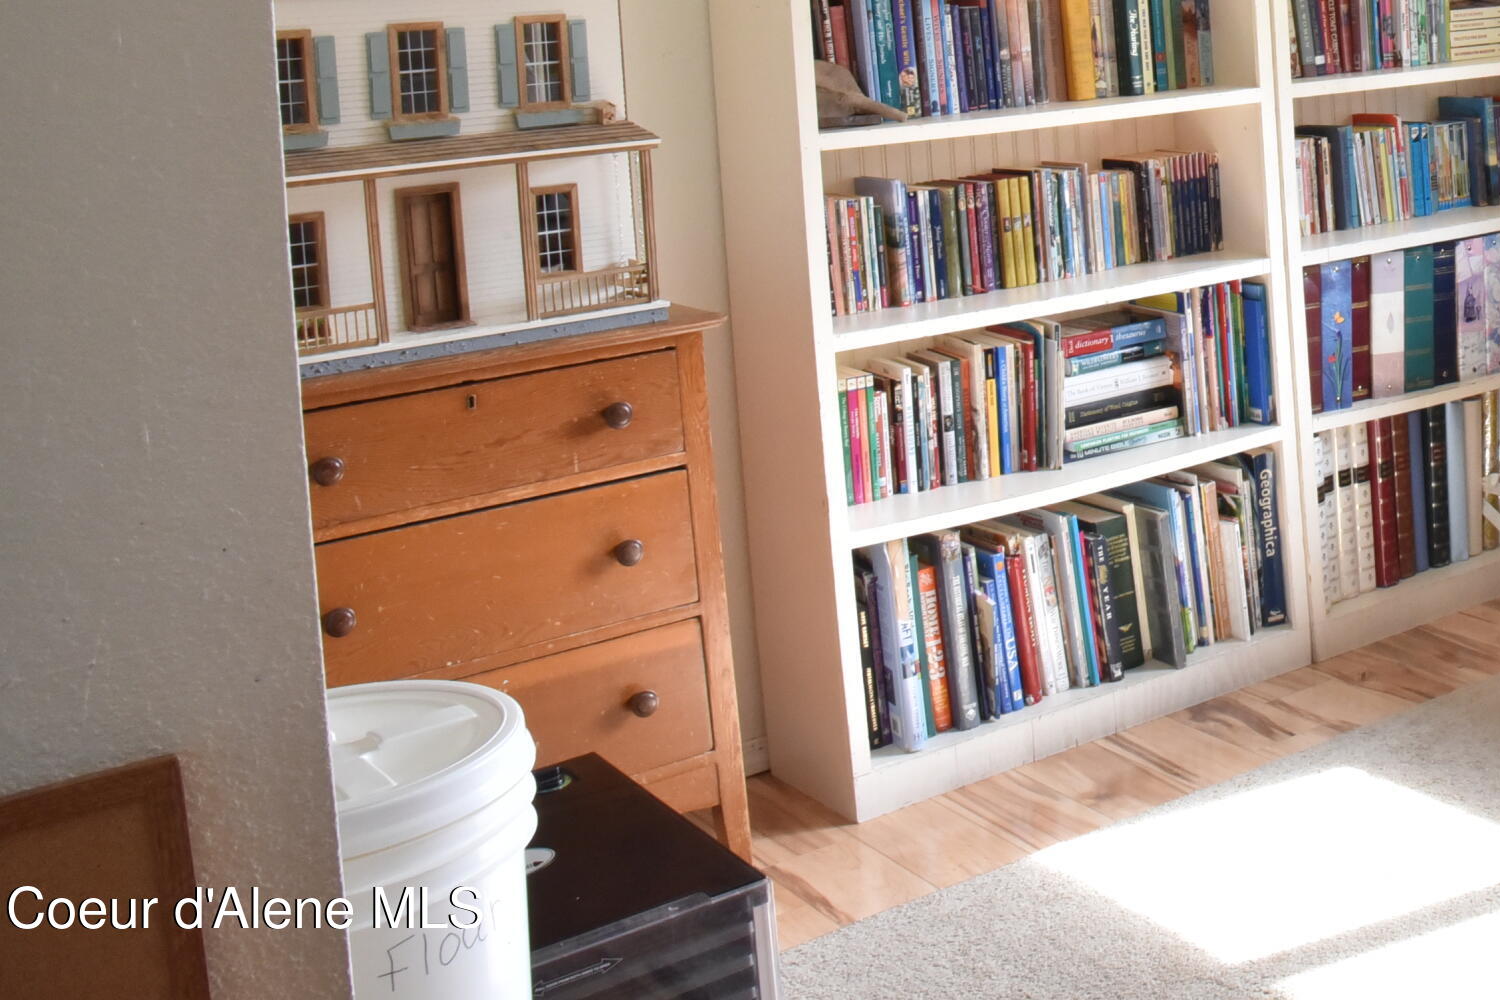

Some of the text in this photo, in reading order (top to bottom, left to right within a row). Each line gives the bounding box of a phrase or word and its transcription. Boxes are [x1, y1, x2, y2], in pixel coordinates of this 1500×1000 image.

[1074, 336, 1109, 349] dictionary
[1115, 329, 1146, 341] thesaurus
[1258, 467, 1276, 558] Geographica
[1096, 544, 1112, 620] THE YEAR
[925, 590, 939, 635] HOME
[1004, 636, 1019, 673] USA
[377, 896, 500, 992] Flour
